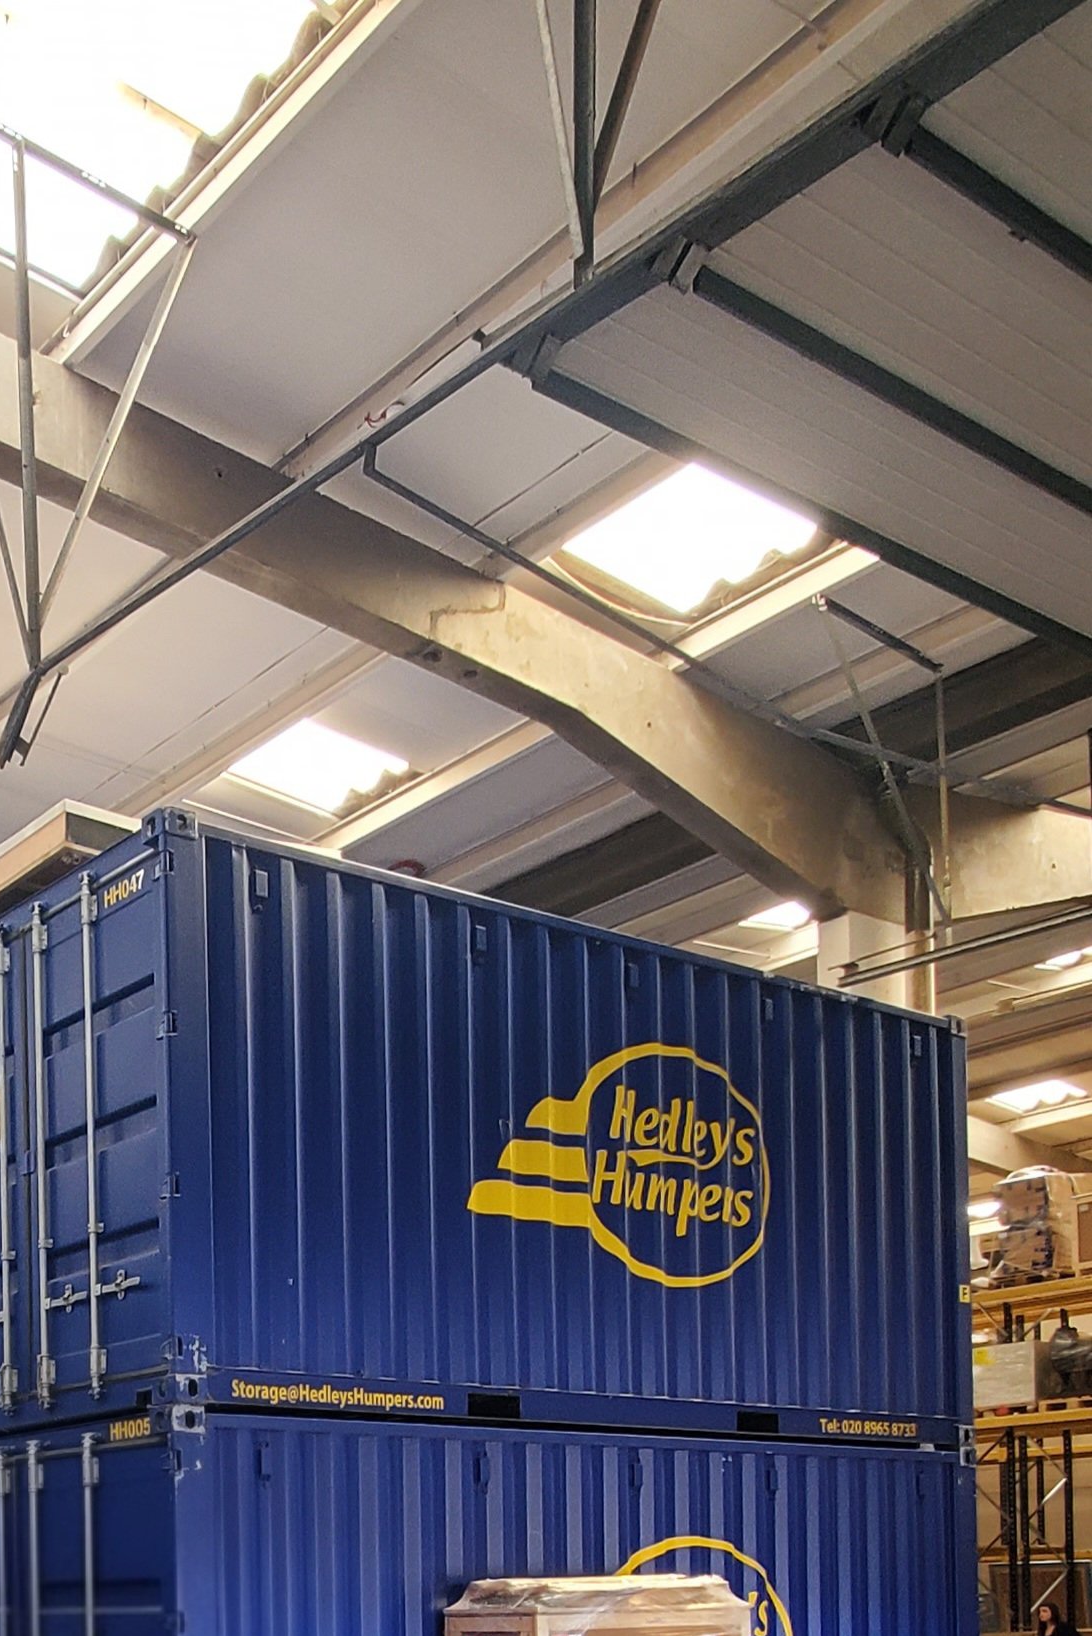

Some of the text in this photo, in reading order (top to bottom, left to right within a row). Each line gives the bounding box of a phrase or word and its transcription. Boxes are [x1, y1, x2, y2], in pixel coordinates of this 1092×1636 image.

[103, 868, 145, 909] HH047
[609, 1085, 756, 1171] Hedley's
[592, 1149, 754, 1237] Humpers
[231, 1378, 445, 1412] Storage@HedleysHumpers.com
[109, 1417, 151, 1441] HH005
[819, 1418, 916, 1437] Tel: 020 8965 8733
